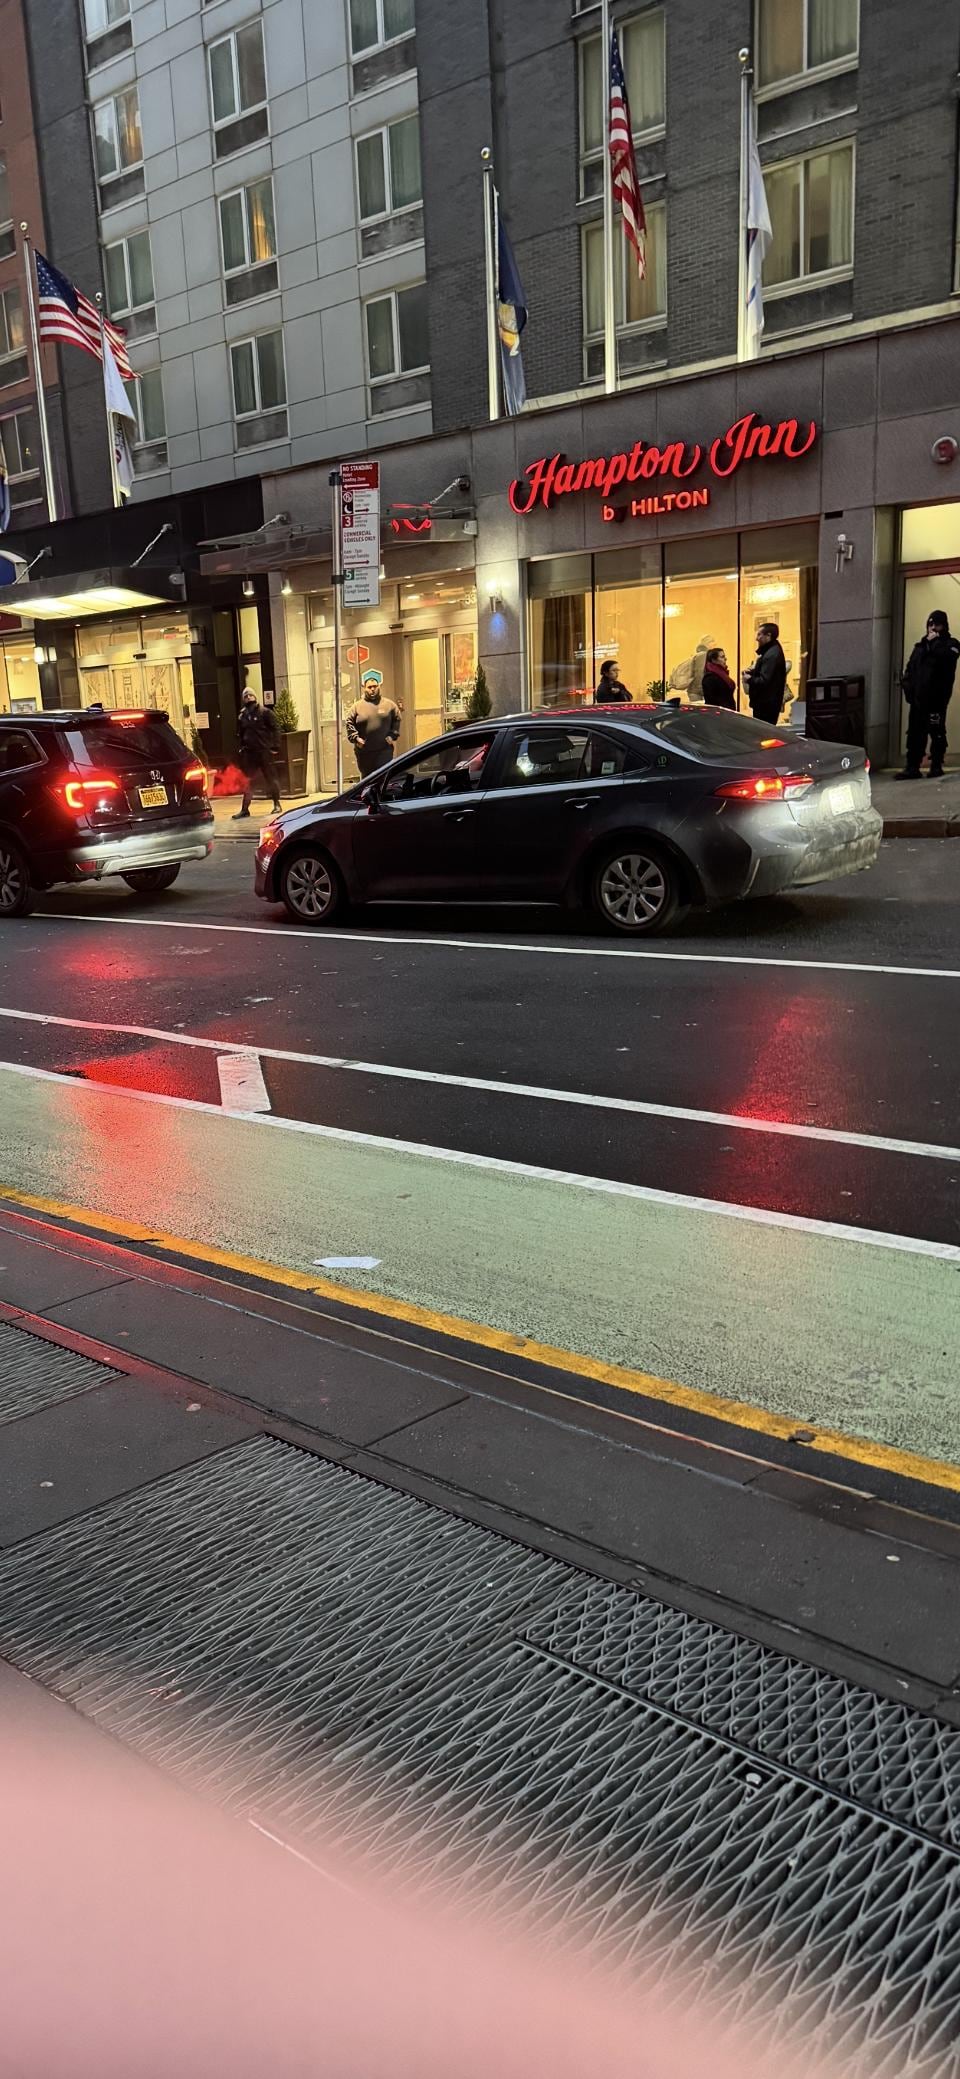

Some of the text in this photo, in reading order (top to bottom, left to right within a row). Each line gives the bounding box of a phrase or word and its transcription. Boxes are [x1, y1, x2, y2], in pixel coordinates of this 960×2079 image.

[509, 413, 816, 513] Hampton Inn
[631, 489, 708, 516] HILTON
[344, 516, 351, 526] 3
[345, 570, 352, 580] 5
